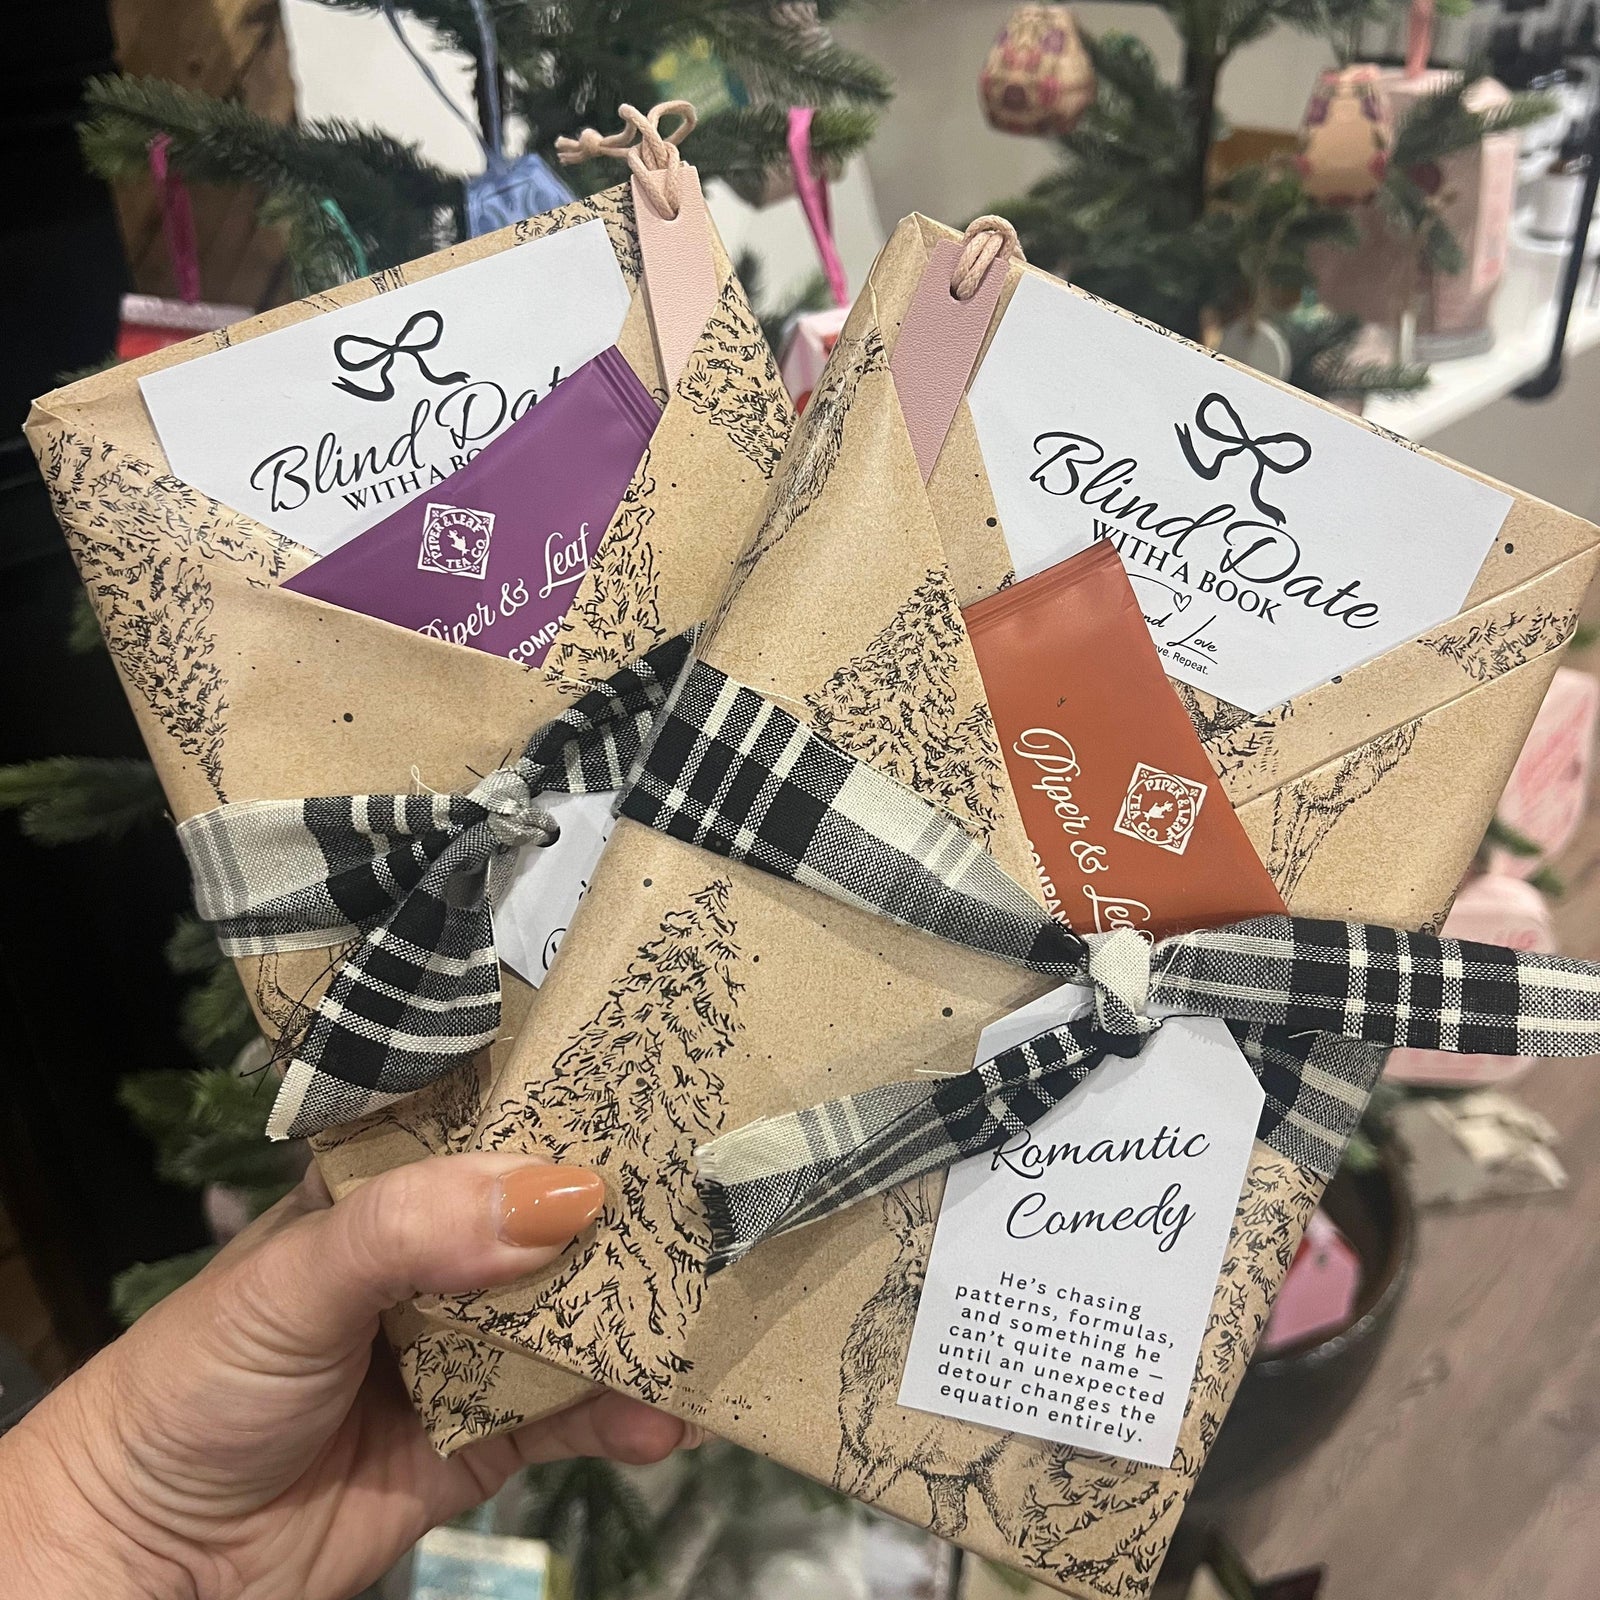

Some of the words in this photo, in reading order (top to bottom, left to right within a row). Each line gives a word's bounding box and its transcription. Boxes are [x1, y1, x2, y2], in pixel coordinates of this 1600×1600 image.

[250, 398, 431, 512] Blind
[434, 365, 568, 449] Dat
[341, 470, 422, 512] WITH
[430, 464, 446, 486] A
[427, 522, 445, 559] PIPER
[443, 515, 454, 527] &
[1029, 431, 1236, 558] Blind
[1219, 520, 1380, 629] Date
[445, 557, 472, 568] TEA
[500, 578, 530, 617] &
[539, 522, 590, 599] Leaf
[1093, 518, 1170, 572] WITH
[1170, 561, 1189, 585] A
[1196, 569, 1282, 625] BOOK
[1143, 612, 1174, 628] nd
[1166, 614, 1219, 660] Love
[1156, 645, 1170, 658] ve.
[1173, 651, 1209, 675] Repeat.
[1013, 727, 1091, 835] Piper
[1069, 840, 1109, 874] &
[1130, 793, 1143, 820] TEA
[1144, 779, 1185, 800] PIPER
[1177, 799, 1190, 809] &
[990, 1125, 1211, 1180] Romantic
[1006, 1183, 1197, 1253] Comedy
[955, 1285, 1059, 1322] patterns,
[1069, 1309, 1175, 1350] formulas,
[999, 1271, 1047, 1295] He’s
[1056, 1287, 1142, 1321] chasing
[949, 1323, 1005, 1348] can’t
[1014, 1339, 1072, 1363] quite
[1081, 1354, 1139, 1379] name
[961, 1306, 1001, 1326] and
[1009, 1317, 1127, 1359] something
[1135, 1344, 1161, 1364] he
[938, 1361, 1013, 1390] detour
[1021, 1382, 1111, 1414] changes
[1120, 1404, 1156, 1425] the
[939, 1342, 991, 1365] until
[999, 1357, 1024, 1373] an
[1034, 1364, 1165, 1406] unexpected
[940, 1383, 1039, 1418] equation
[1048, 1409, 1143, 1443] entirely.
